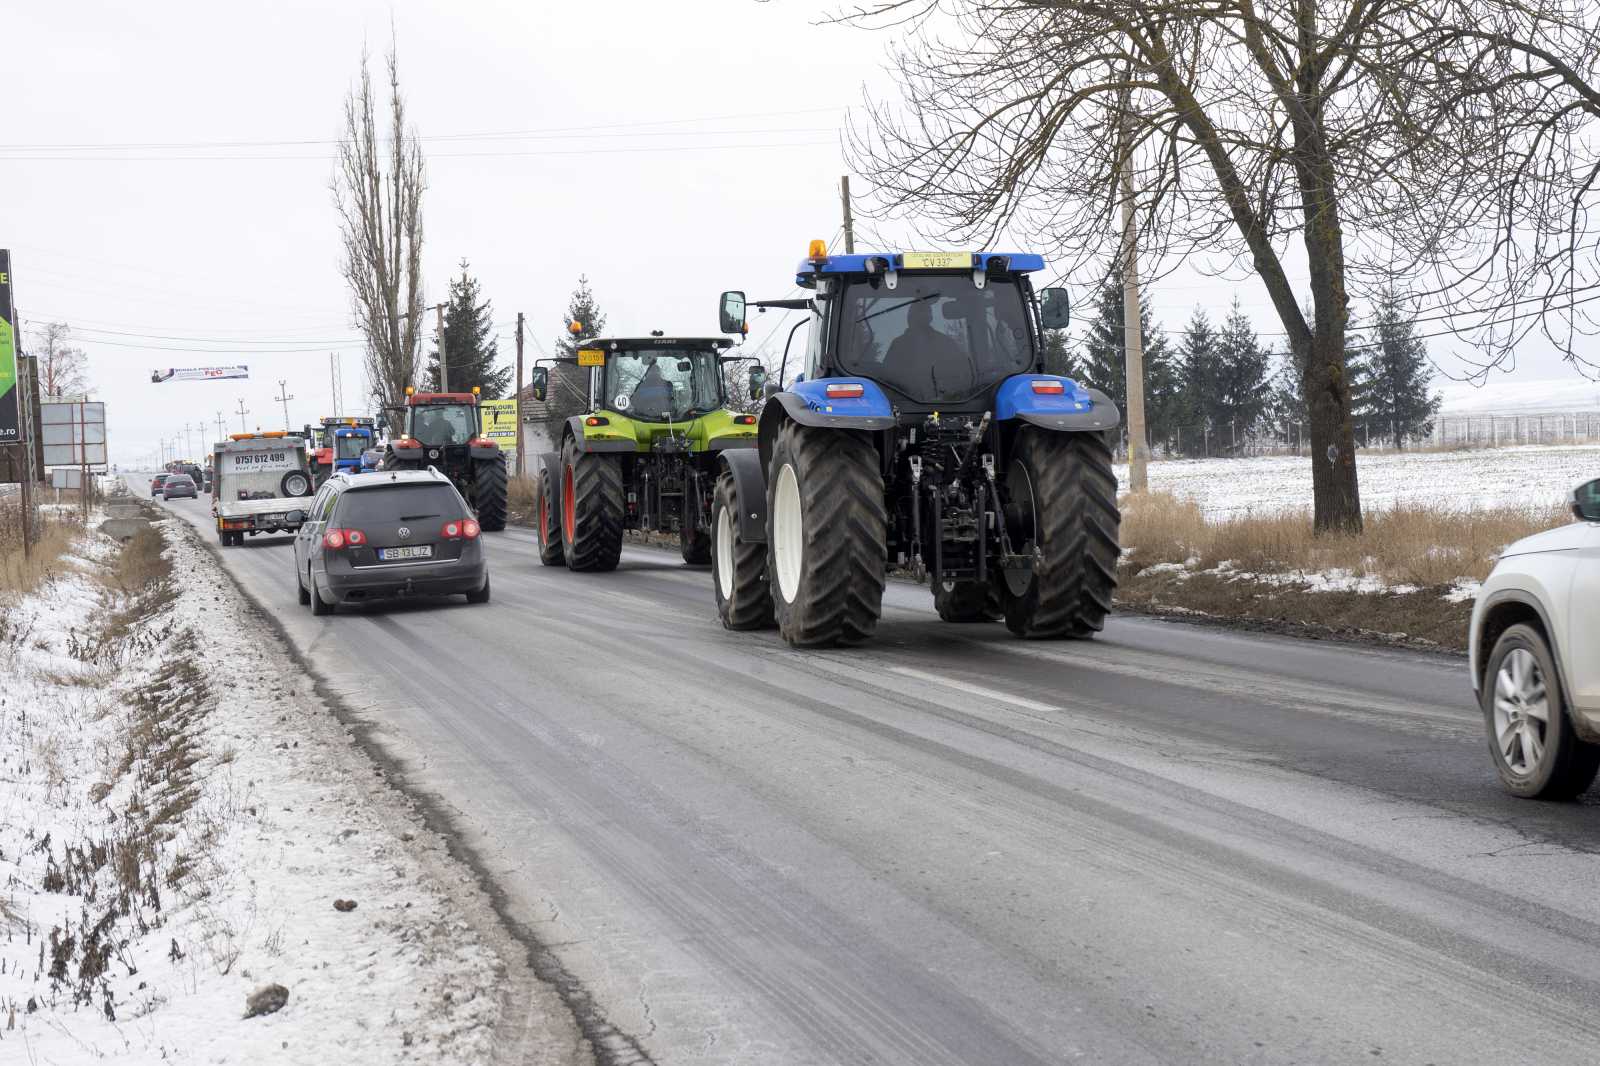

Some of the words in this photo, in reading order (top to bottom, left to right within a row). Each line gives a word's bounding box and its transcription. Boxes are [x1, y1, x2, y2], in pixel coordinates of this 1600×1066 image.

[617, 397, 627, 407] 40
[235, 455, 253, 465] 0757
[254, 454, 268, 463] 612
[269, 453, 285, 462] 499
[385, 548, 399, 559] SB
